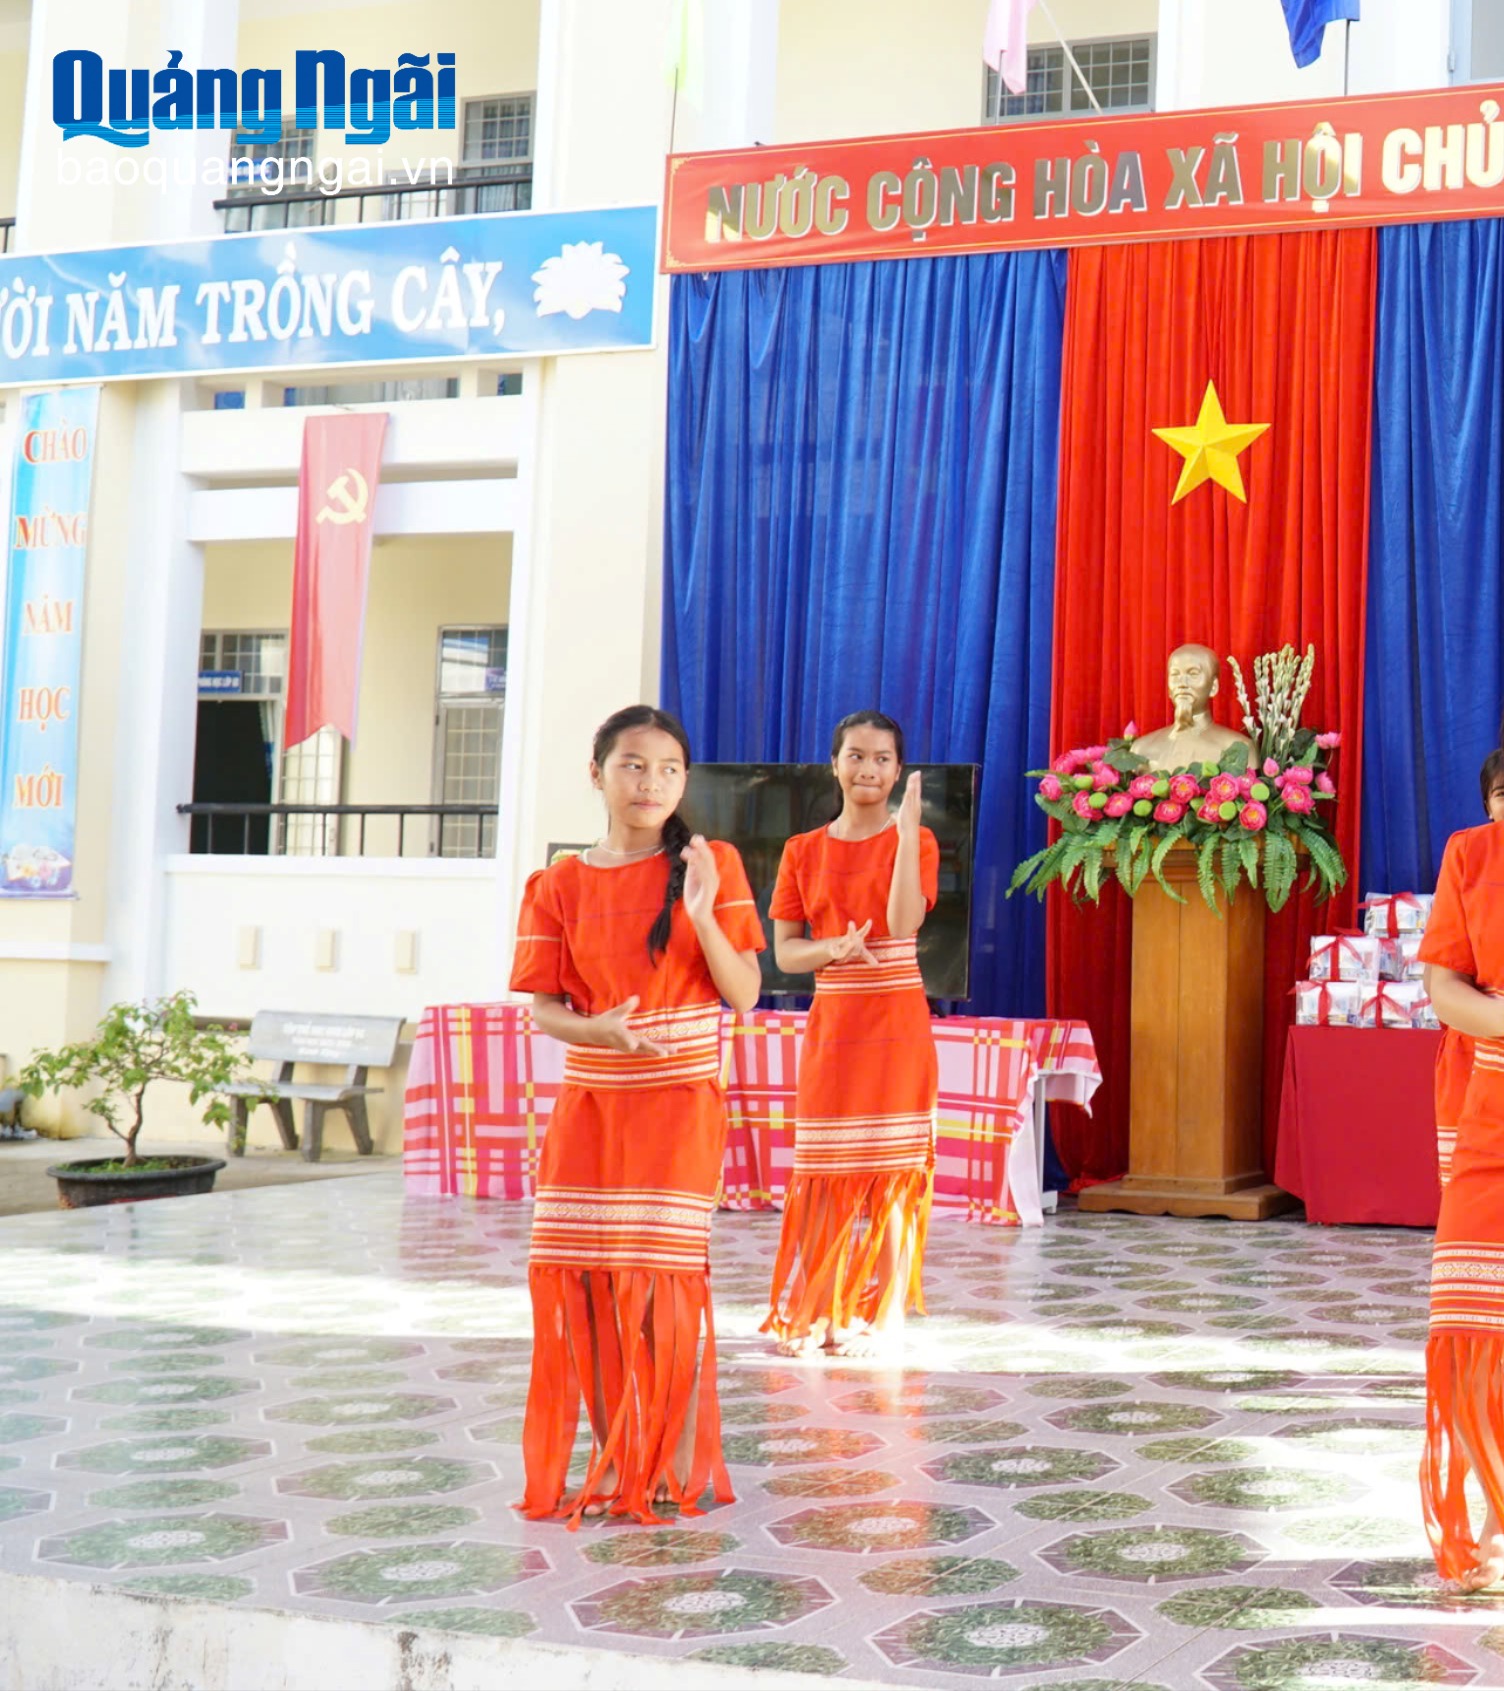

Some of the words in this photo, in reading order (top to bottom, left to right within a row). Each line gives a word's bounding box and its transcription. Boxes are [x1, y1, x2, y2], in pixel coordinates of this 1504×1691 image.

[703, 166, 850, 243] NƯỚC
[865, 156, 1017, 240] CỘNG
[1034, 139, 1147, 219] HÒA
[1164, 131, 1244, 209] XÃ
[1261, 121, 1361, 212] HỘI
[63, 271, 180, 354] NĂM
[195, 241, 375, 342] TRỒNG
[391, 246, 504, 336] CÂY,
[24, 418, 88, 464] CHÀO
[15, 506, 87, 549] MỪNG
[22, 594, 74, 635] NĂM
[17, 686, 70, 731] HỌC
[13, 765, 66, 810] MỚI
